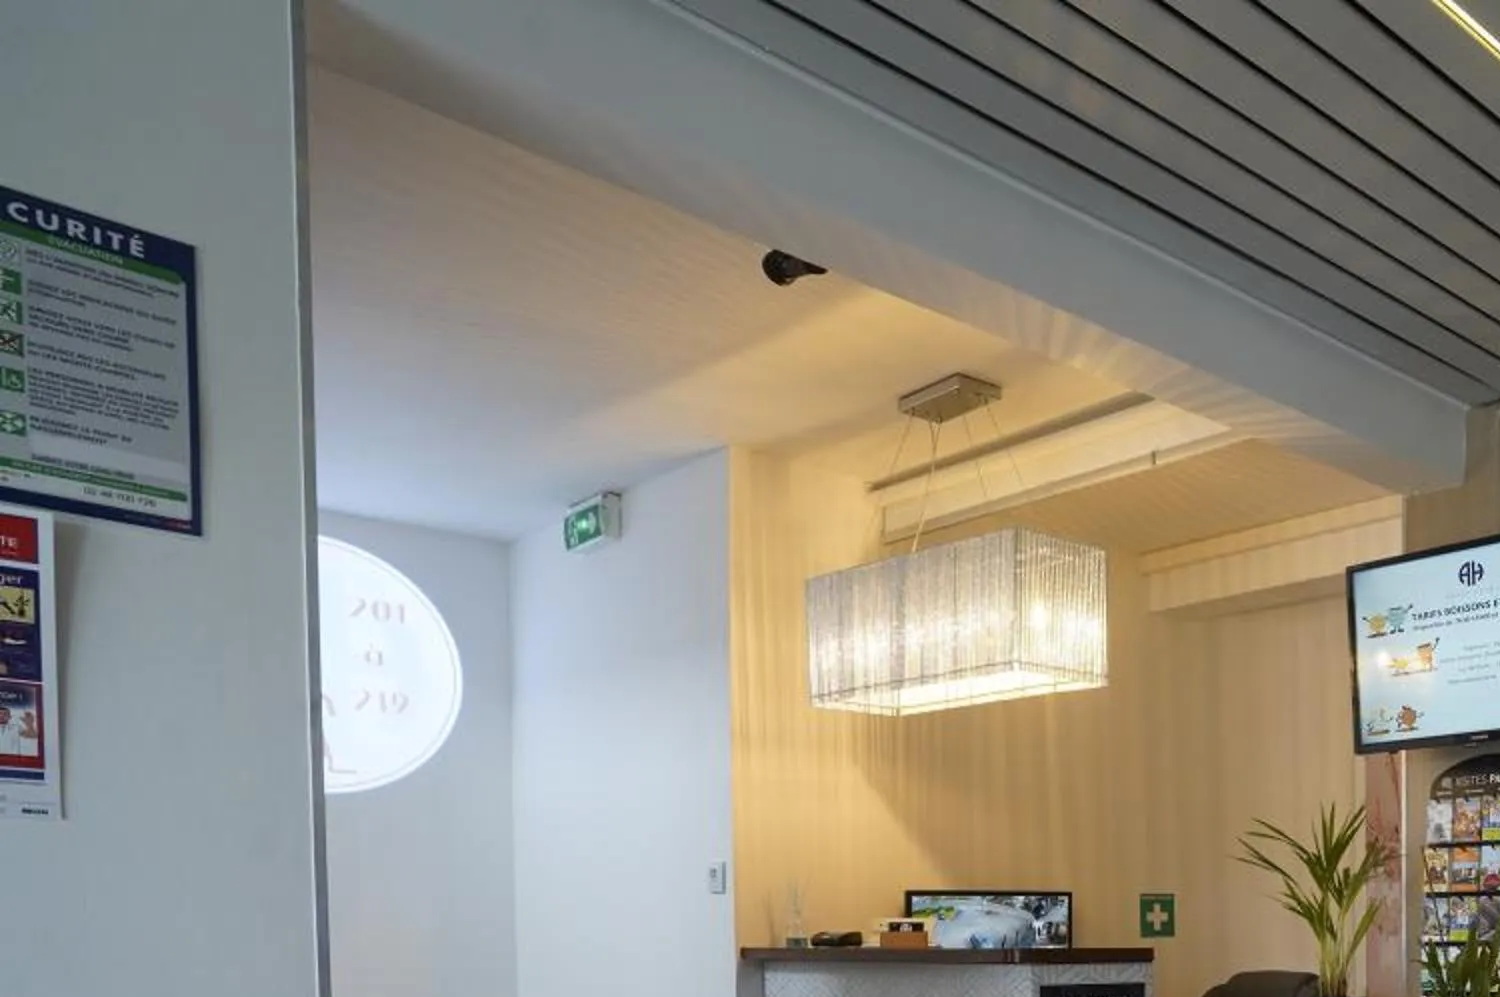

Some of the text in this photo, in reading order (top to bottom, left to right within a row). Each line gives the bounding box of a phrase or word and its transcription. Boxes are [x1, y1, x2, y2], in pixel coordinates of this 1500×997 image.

[6, 201, 146, 260] CURITÉ
[350, 597, 405, 625] 201
[1444, 599, 1491, 617] BOISSONS
